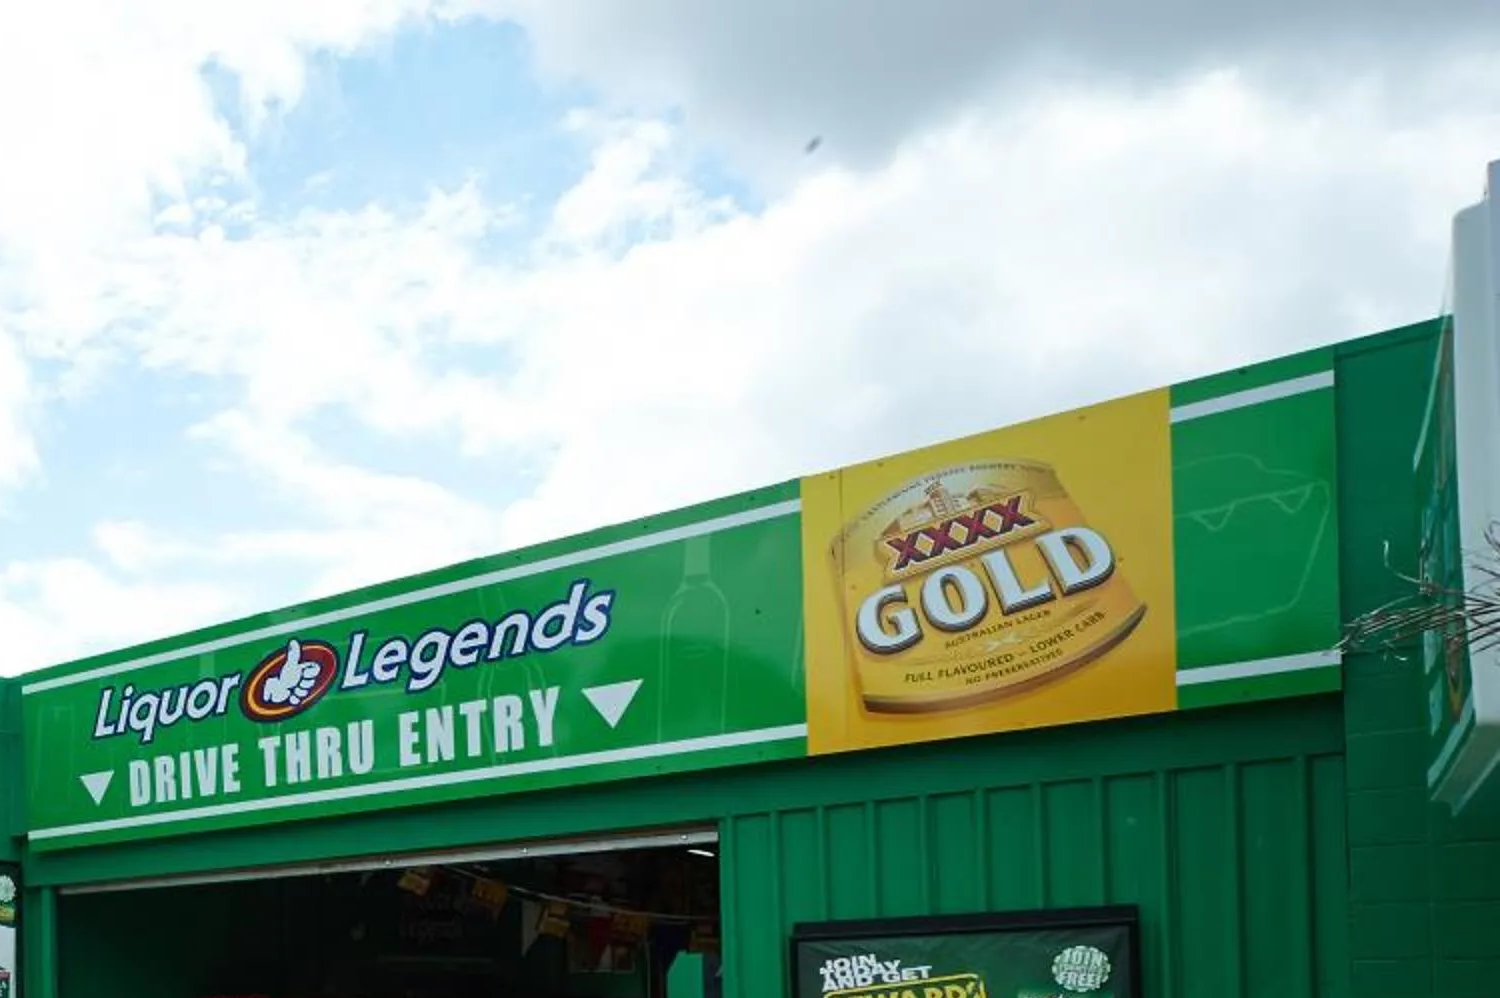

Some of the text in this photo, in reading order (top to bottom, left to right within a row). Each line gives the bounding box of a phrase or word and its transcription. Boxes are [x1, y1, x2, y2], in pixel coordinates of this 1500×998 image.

[887, 495, 1036, 571] XXXX
[856, 526, 1117, 654] GOLD
[94, 579, 614, 742] Liquor Legends
[905, 672, 933, 683] FULL
[938, 653, 1015, 679] FLAVOURED
[1030, 630, 1074, 653] LOWER
[129, 686, 561, 807] DRIVE THRU ENTRY
[822, 966, 932, 992] AND GET
[824, 954, 877, 970] JOIN
